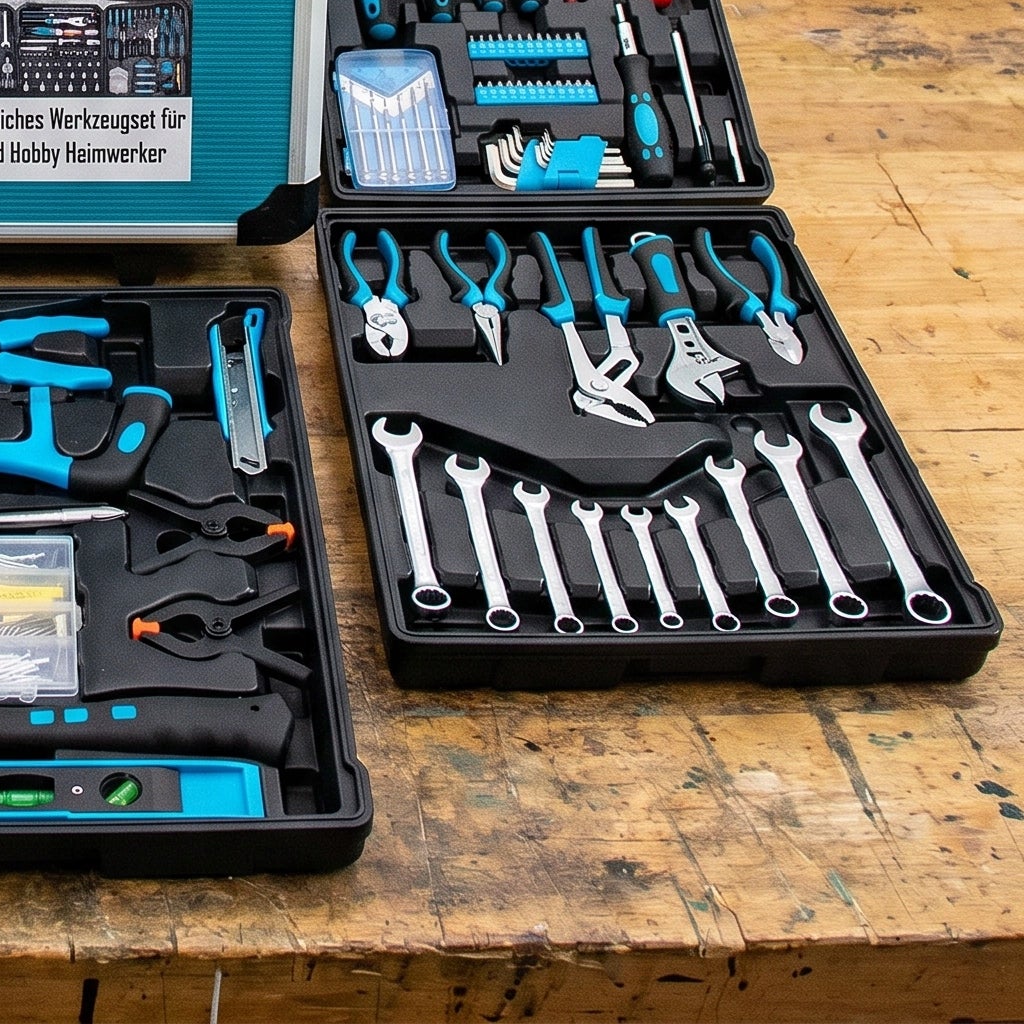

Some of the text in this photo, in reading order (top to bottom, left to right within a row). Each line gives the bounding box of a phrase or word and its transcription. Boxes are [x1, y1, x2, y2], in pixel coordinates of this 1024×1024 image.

[49, 107, 156, 135] Werkzeugset
[161, 107, 187, 130] für
[10, 141, 61, 169] Hobby
